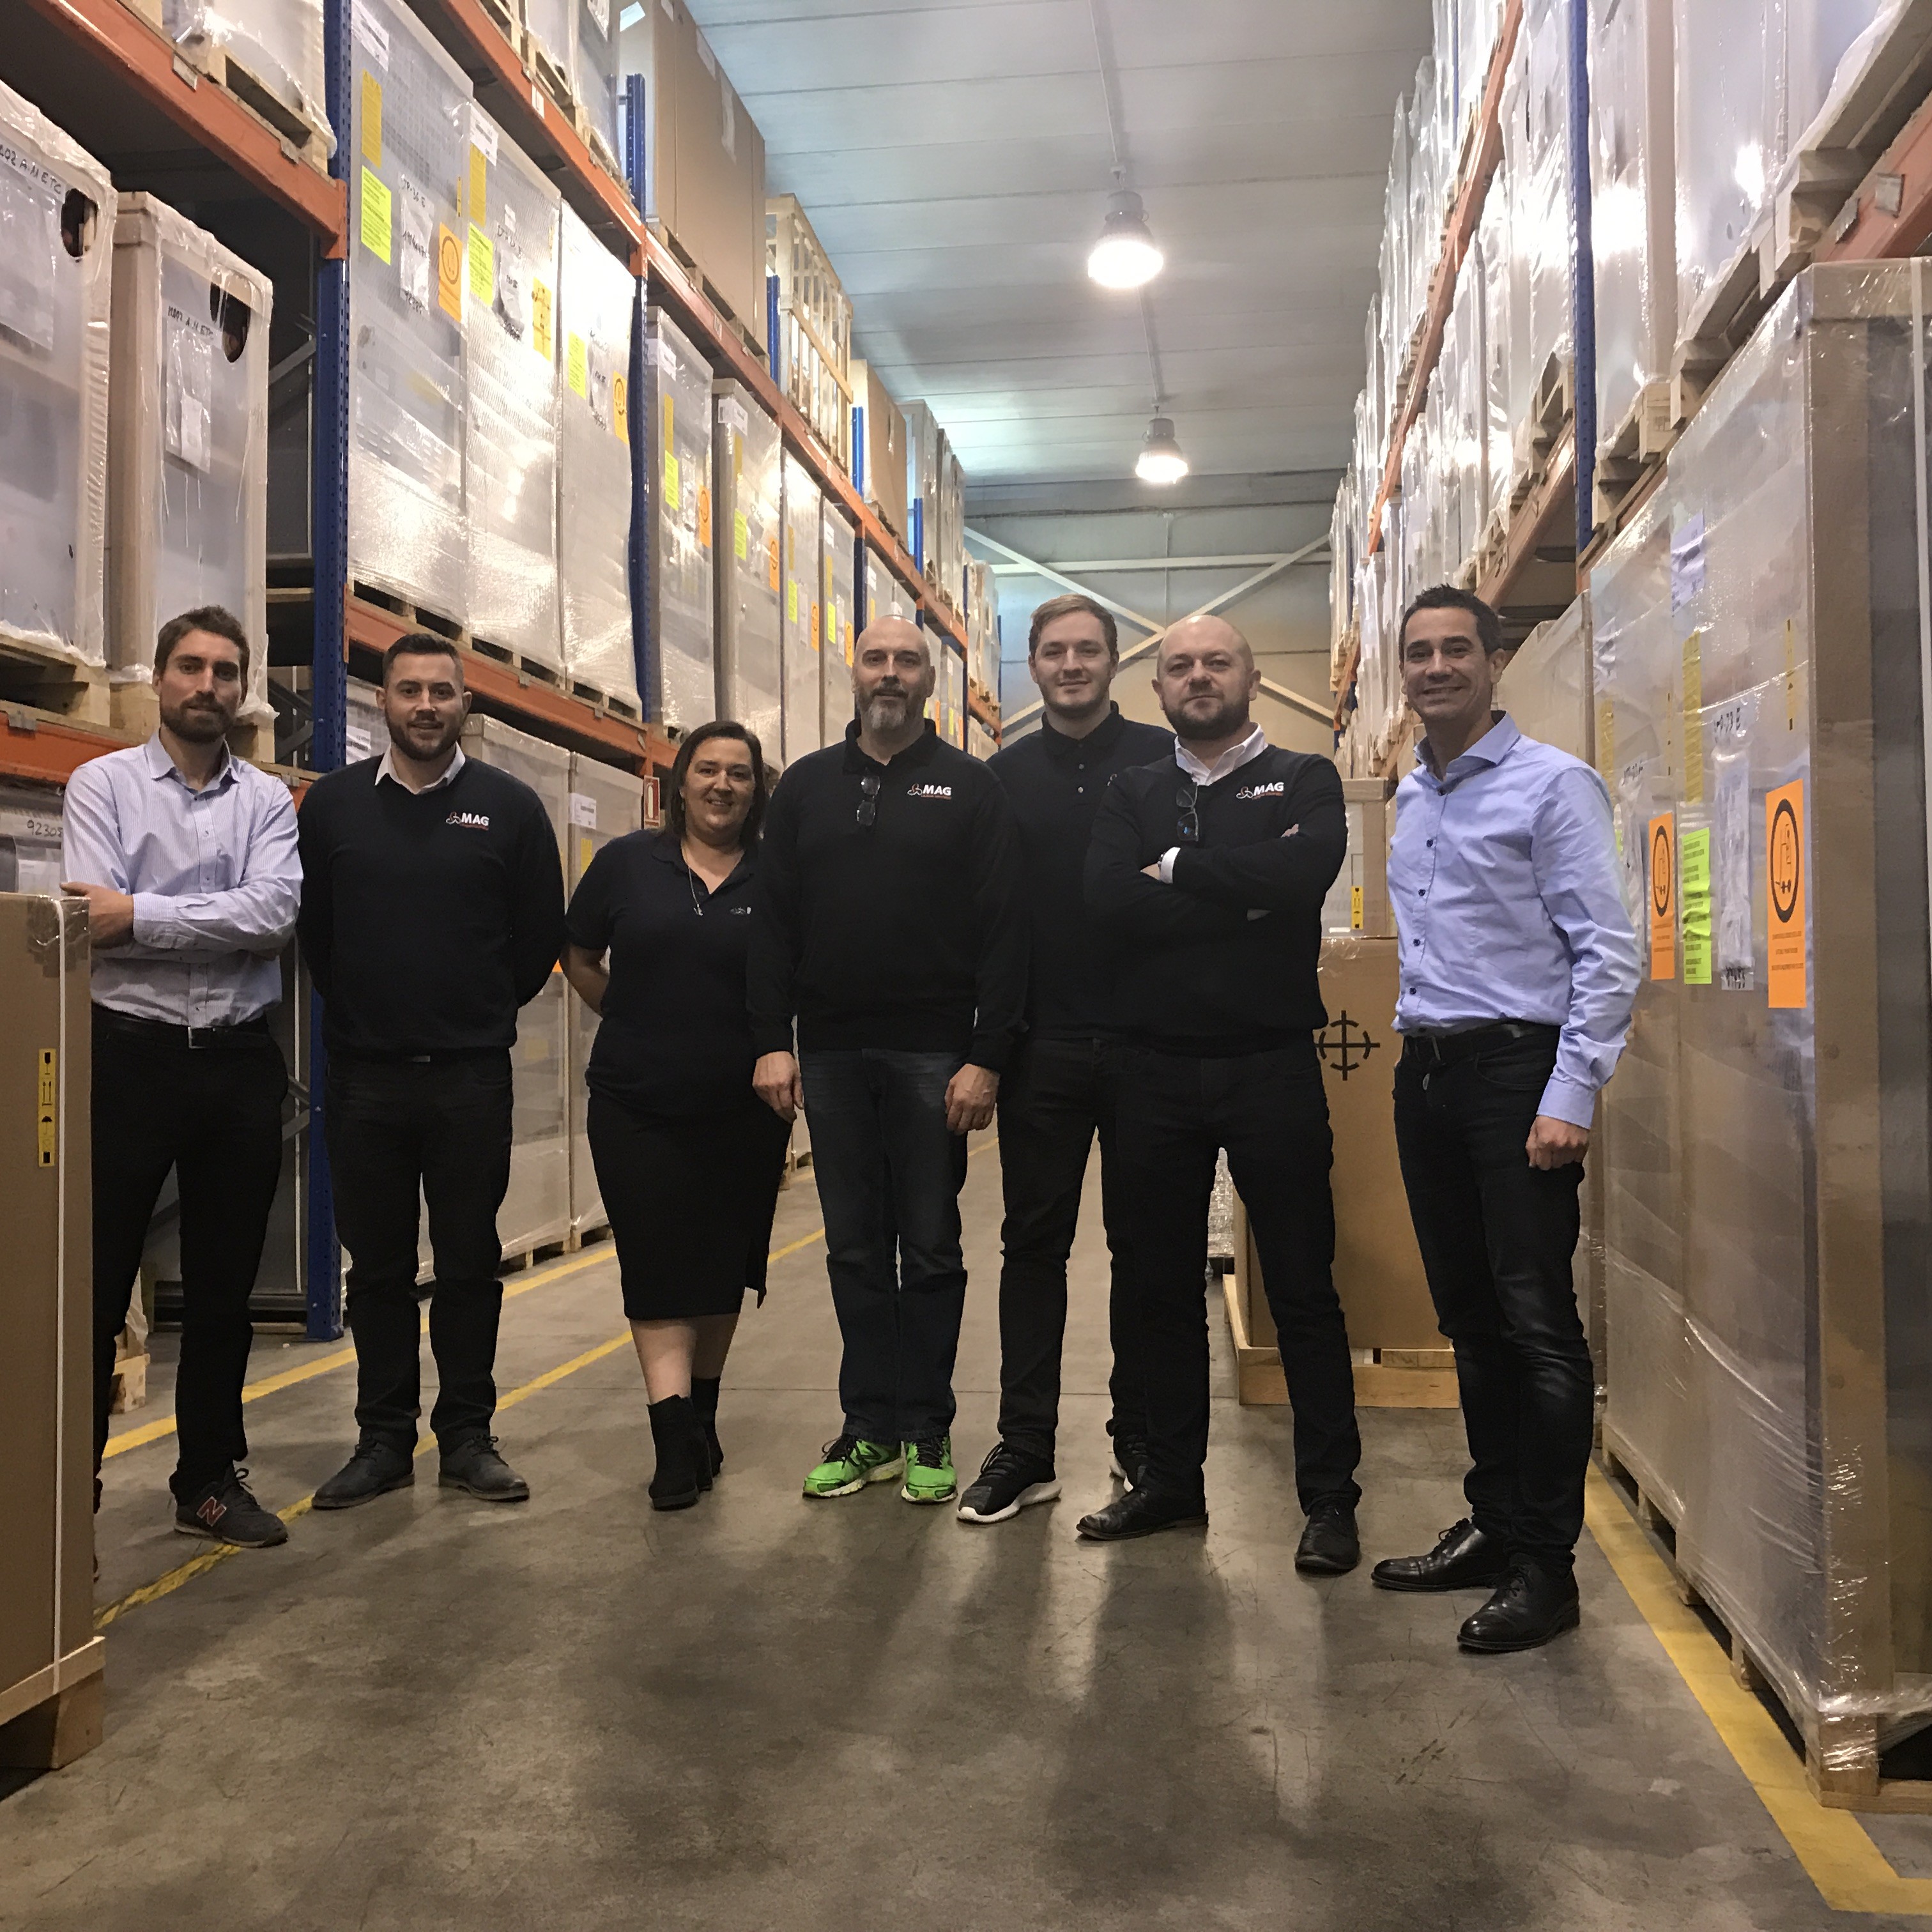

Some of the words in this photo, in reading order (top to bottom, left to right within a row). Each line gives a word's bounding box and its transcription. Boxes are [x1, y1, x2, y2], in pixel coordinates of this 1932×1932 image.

[922, 785, 952, 796] MAG
[1253, 781, 1285, 797] MAG
[461, 812, 490, 827] MAG
[196, 1496, 227, 1527] N
